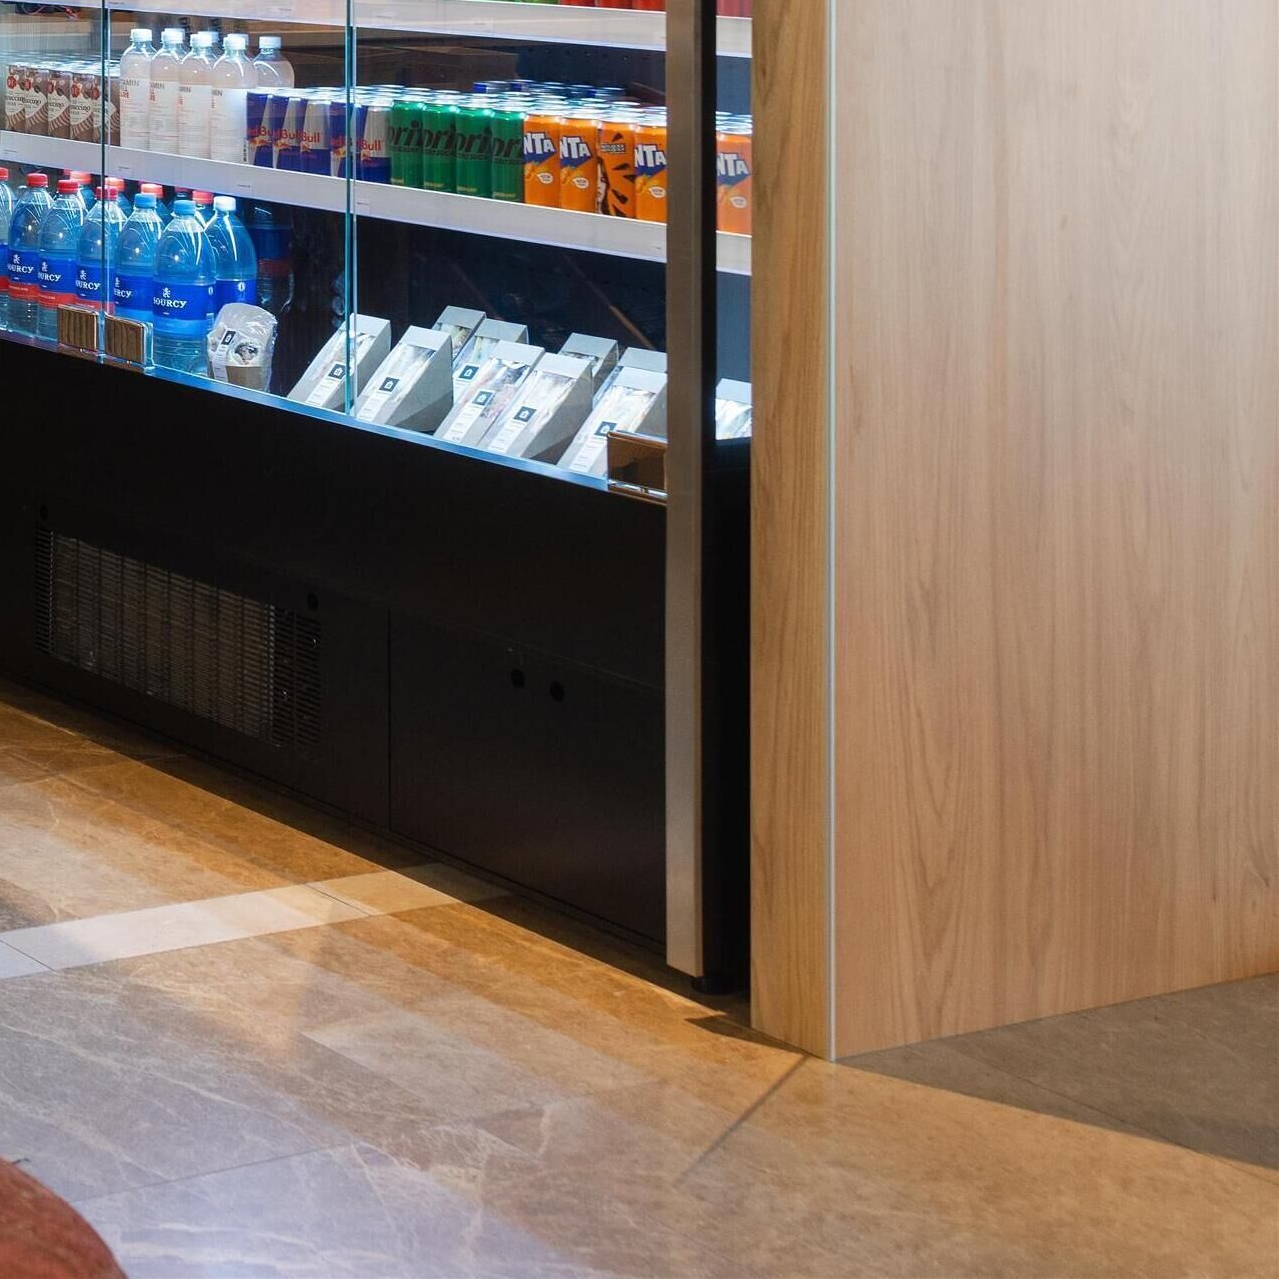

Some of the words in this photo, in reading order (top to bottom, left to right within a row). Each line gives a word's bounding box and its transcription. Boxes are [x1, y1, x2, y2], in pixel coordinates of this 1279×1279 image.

[361, 140, 381, 150] Bull
[524, 133, 556, 154] NTA
[560, 136, 591, 159] NTA
[635, 145, 666, 167] NTA
[717, 153, 749, 176] NTA
[153, 297, 186, 309] SOURCY
